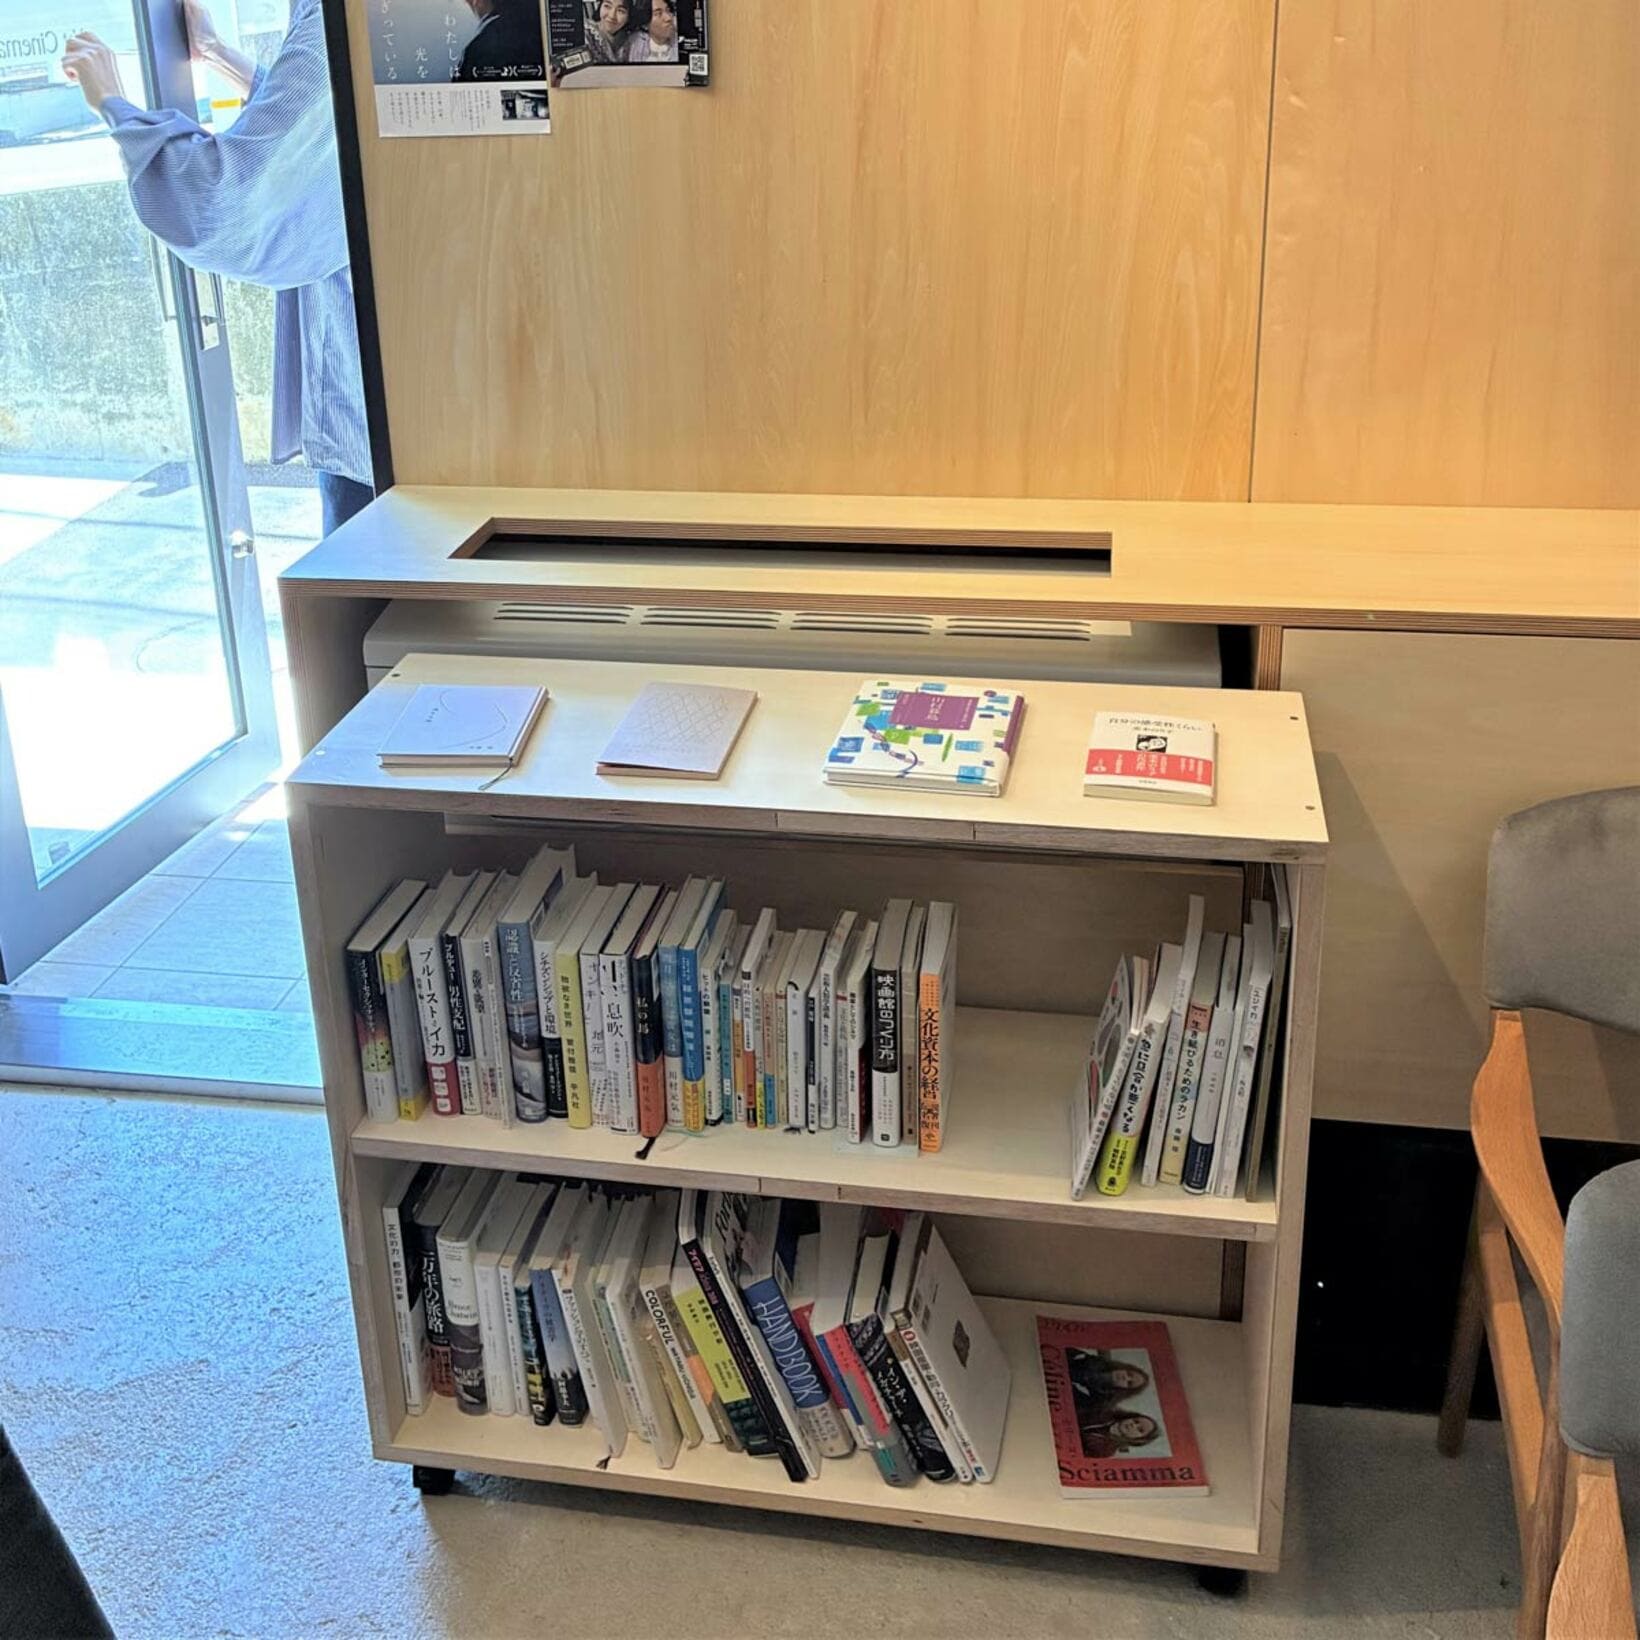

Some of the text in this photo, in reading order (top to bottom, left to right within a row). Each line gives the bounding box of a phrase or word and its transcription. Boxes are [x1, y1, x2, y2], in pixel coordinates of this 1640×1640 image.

[416, 47, 429, 79] 光を
[445, 15, 461, 78] わたしは
[607, 1003, 624, 1038] 息吹
[921, 1008, 939, 1100] 文化資本の経営
[570, 1083, 580, 1110] 平凡社
[669, 1070, 680, 1113] 川村元気
[646, 1289, 676, 1345] COLORFUL
[753, 1296, 823, 1402] HANDBOOK
[1058, 1460, 1195, 1482] Sciamma
